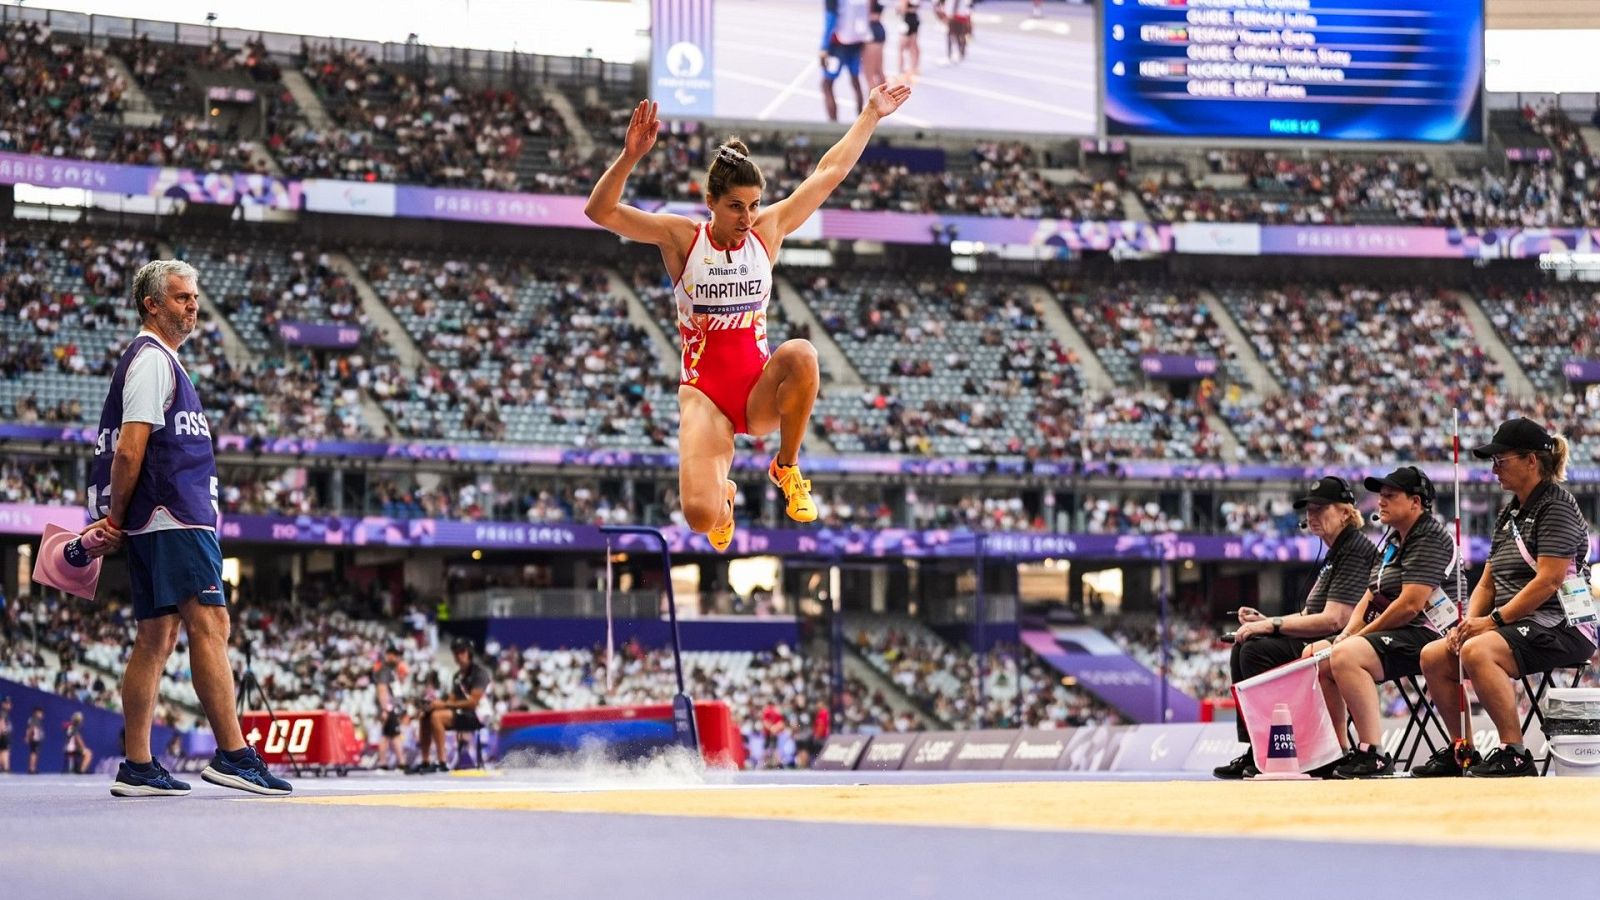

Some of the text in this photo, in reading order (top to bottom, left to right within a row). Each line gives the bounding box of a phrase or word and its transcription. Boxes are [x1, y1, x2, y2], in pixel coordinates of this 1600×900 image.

[51, 165, 107, 186] 2024
[434, 195, 492, 216] PARIS
[1296, 232, 1352, 248] PARIS
[709, 267, 738, 276] Allianz
[695, 280, 762, 299] MARTINEZ
[475, 525, 575, 545] PARIS 2024
